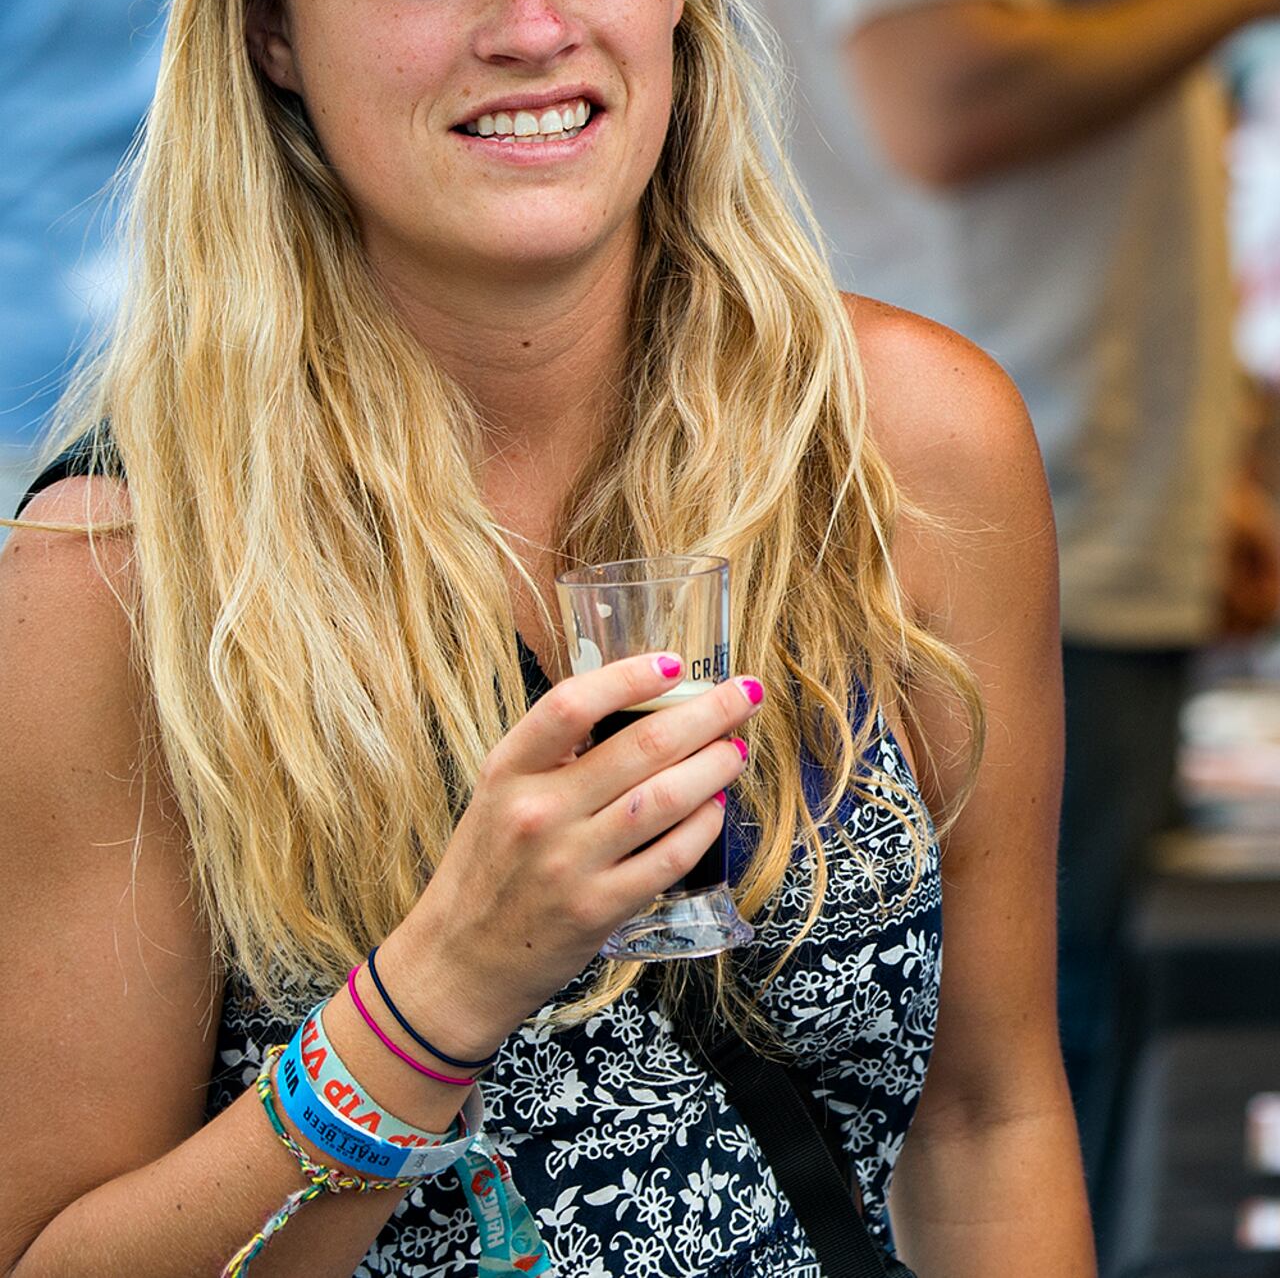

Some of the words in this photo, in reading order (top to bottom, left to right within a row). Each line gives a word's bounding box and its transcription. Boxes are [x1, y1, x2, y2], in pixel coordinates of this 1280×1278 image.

[284, 1058, 300, 1098] VIP
[303, 1106, 338, 1143] BEER
[323, 1078, 382, 1134] VIP
[337, 1138, 391, 1168] CRAFT
